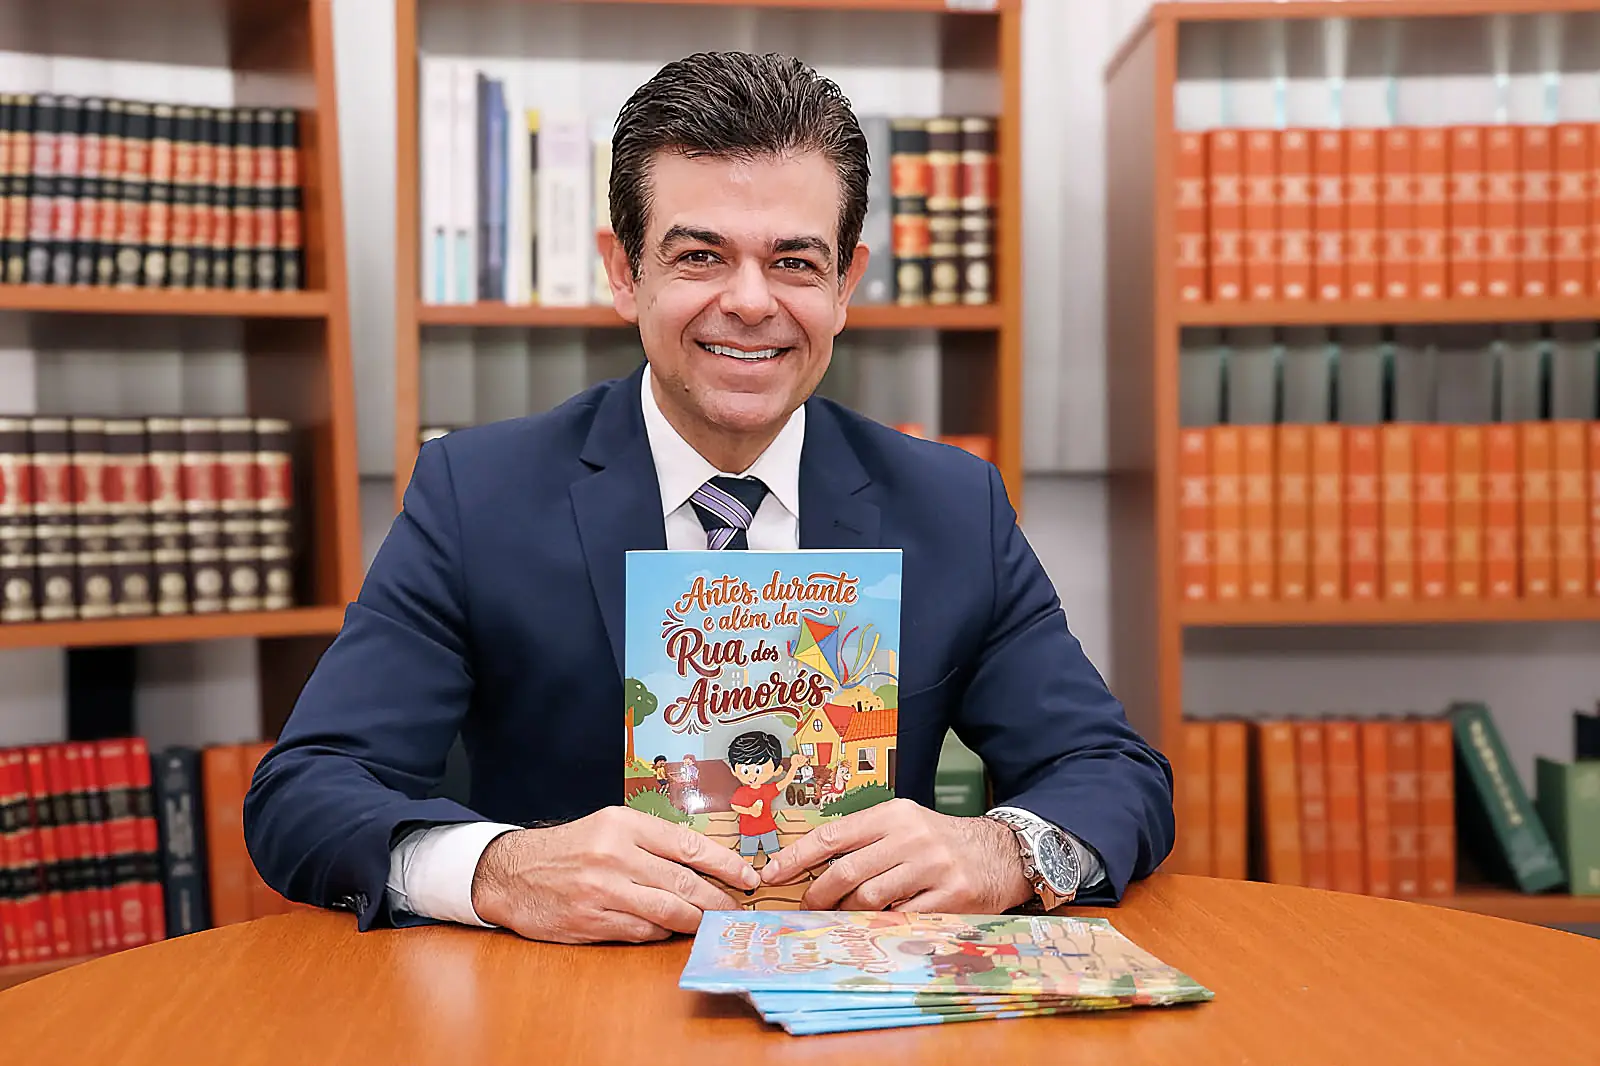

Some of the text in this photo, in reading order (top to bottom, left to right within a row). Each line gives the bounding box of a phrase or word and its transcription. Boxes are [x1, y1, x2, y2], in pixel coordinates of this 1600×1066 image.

[675, 571, 859, 613] Antes, durante
[703, 603, 799, 632] e além da
[666, 628, 779, 679] Rua dos
[664, 669, 833, 727] Aimorés
